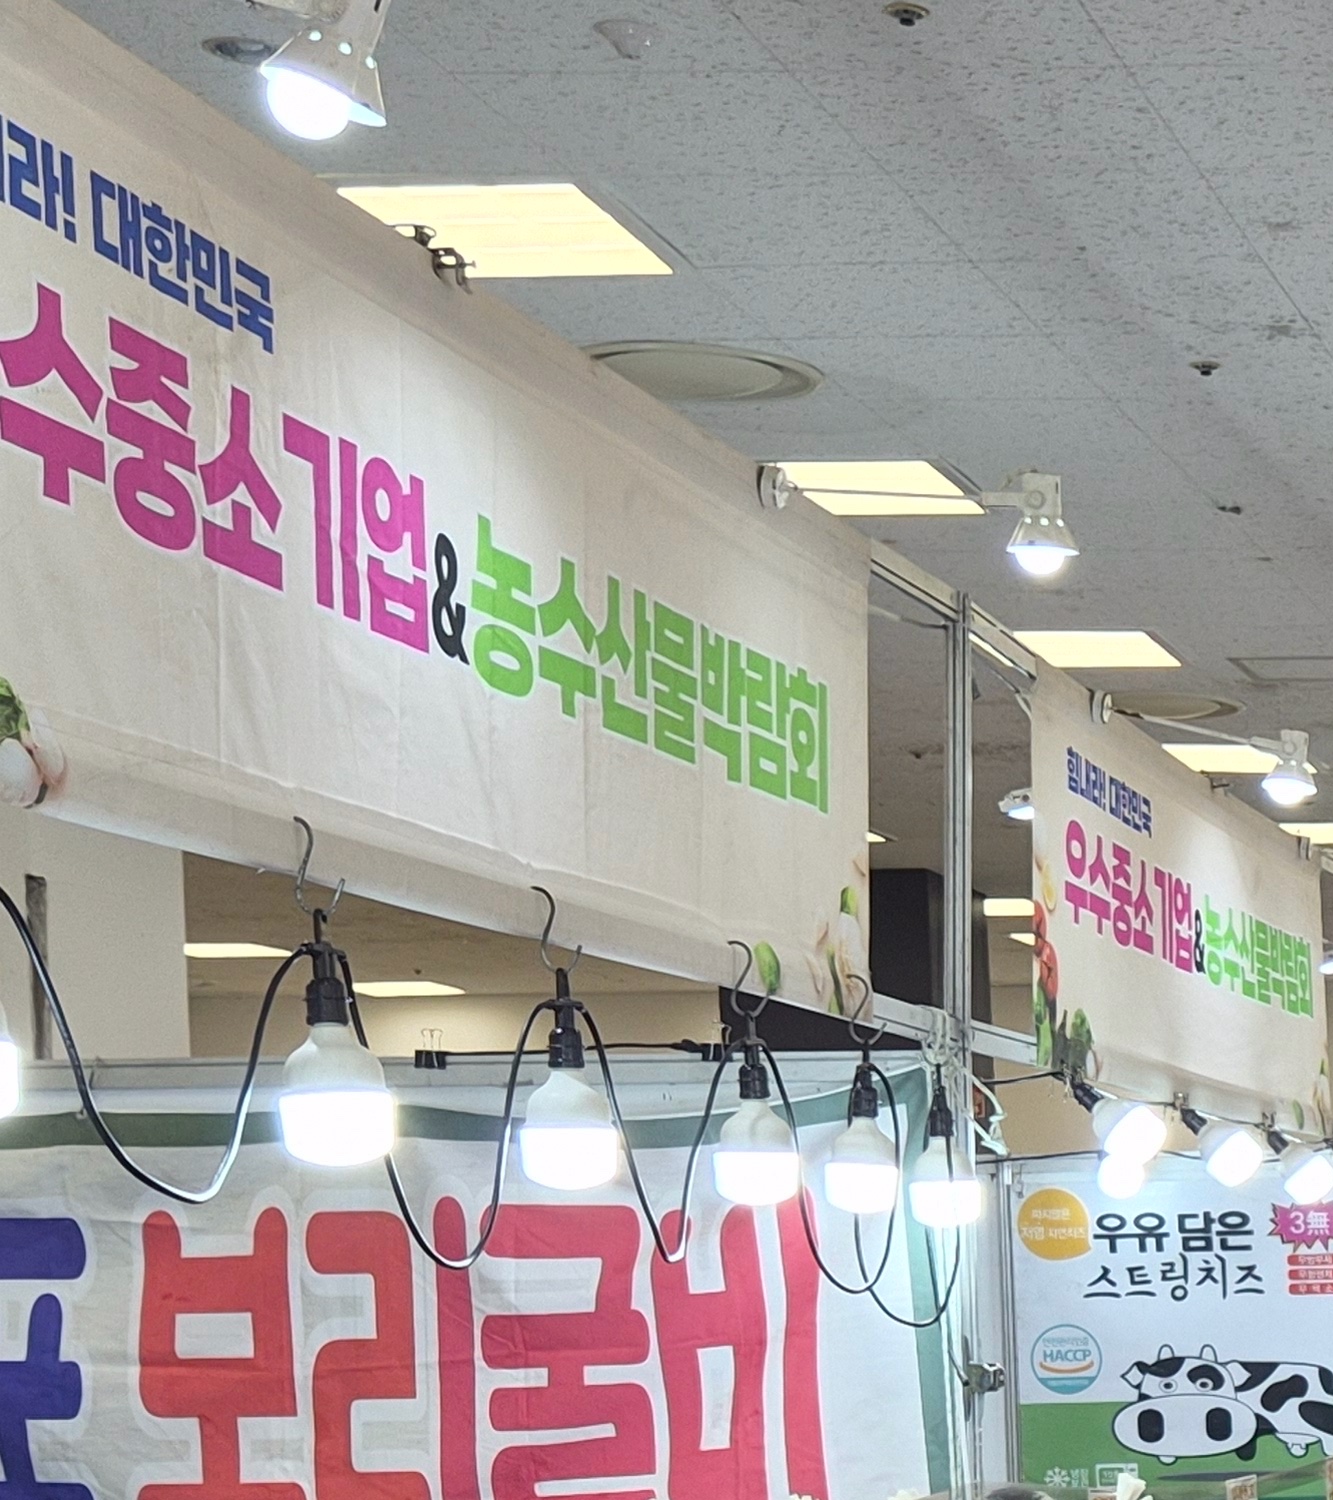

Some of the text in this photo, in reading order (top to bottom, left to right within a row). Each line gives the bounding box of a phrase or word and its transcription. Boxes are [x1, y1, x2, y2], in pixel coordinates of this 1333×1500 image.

[0, 118, 274, 354] 라! 대한민국
[1067, 746, 1153, 838] 힘내라! 대한민국
[1092, 1210, 1255, 1254] 우유 담은
[1289, 1210, 1331, 1236] 3無
[1083, 1252, 1266, 1302] 스트링치즈
[1043, 1349, 1093, 1363] HACCP
